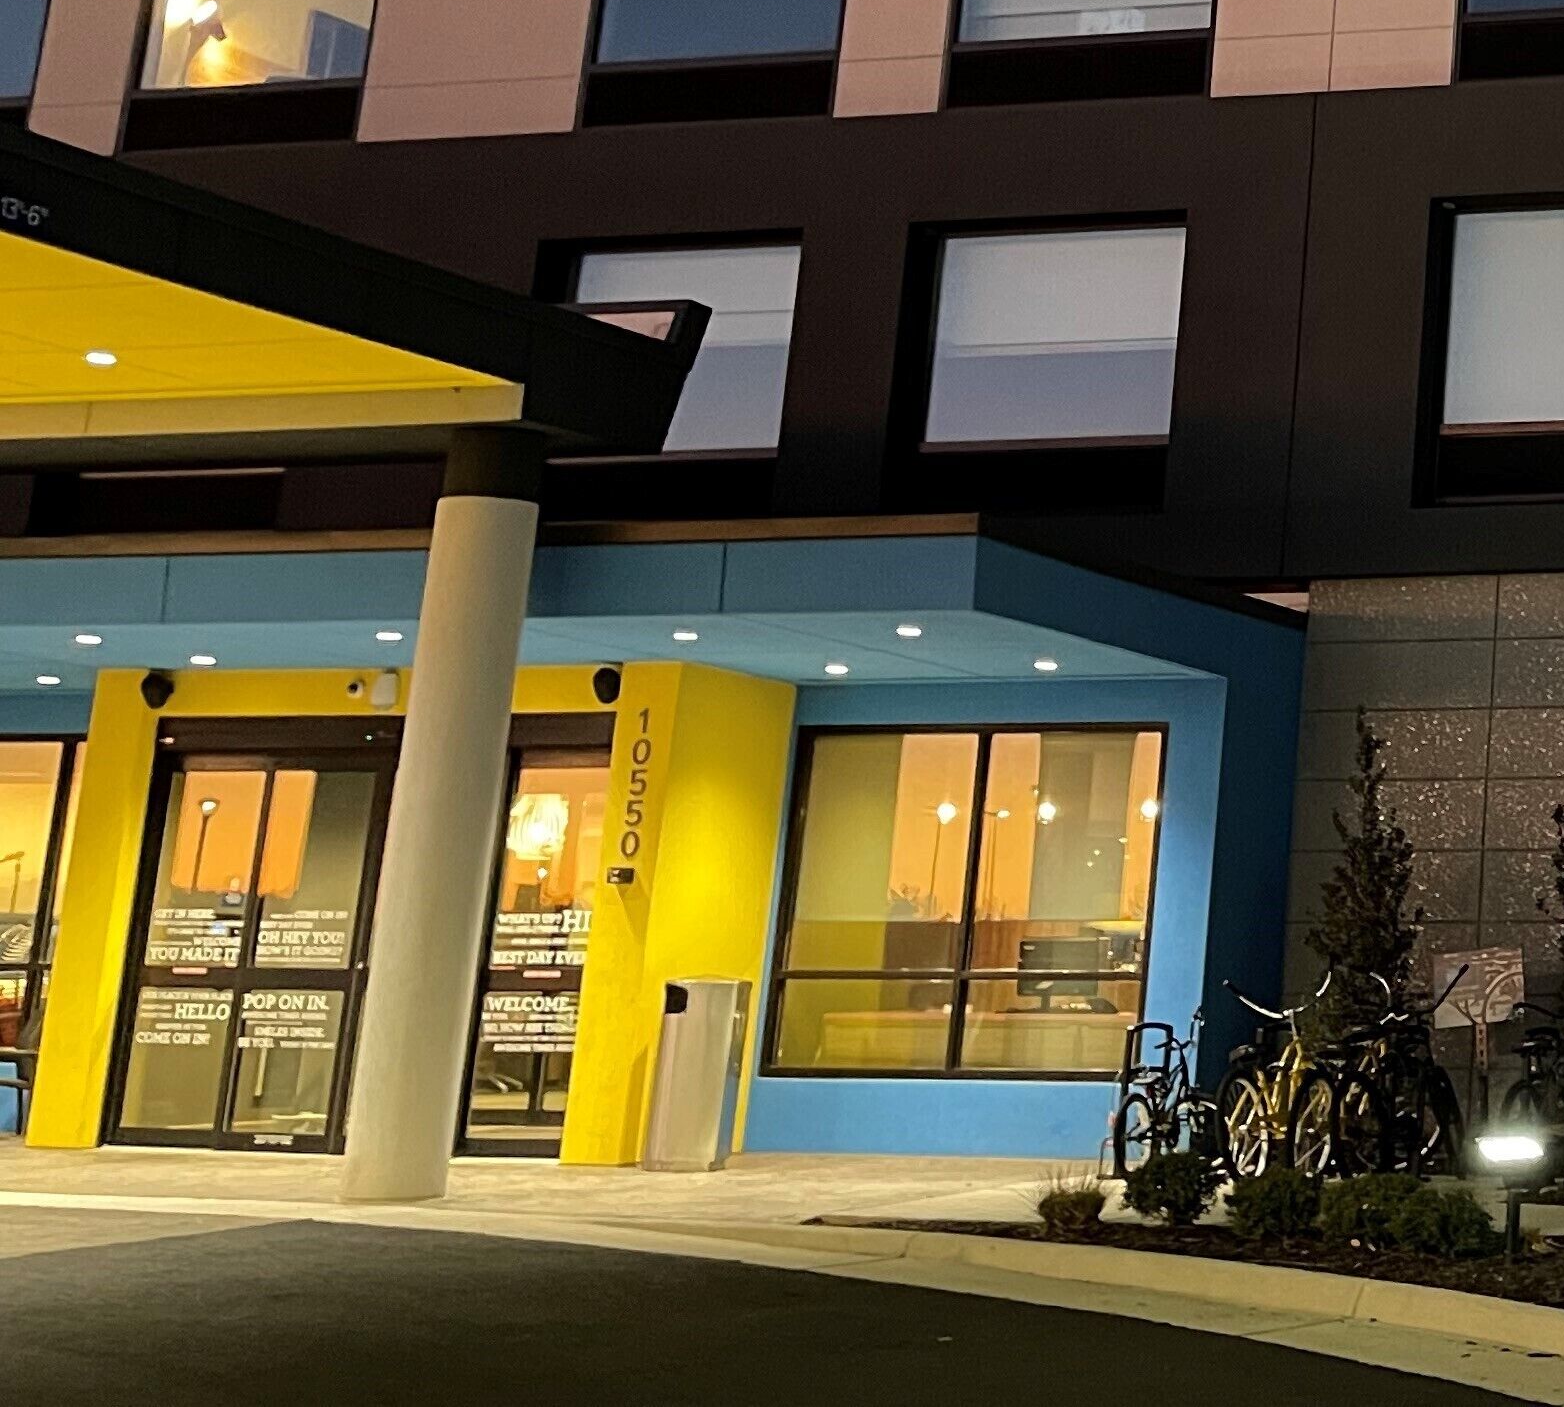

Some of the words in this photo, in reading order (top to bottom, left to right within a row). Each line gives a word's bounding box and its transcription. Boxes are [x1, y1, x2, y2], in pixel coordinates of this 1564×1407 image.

[620, 708, 652, 859] 10550
[257, 930, 281, 944] OH
[281, 930, 311, 945] HEY
[149, 947, 180, 961] YOU
[180, 947, 223, 962] MADE
[492, 950, 529, 965] BEST
[526, 950, 557, 965] DAY
[241, 993, 277, 1010] POP
[278, 994, 306, 1010] ON
[174, 1002, 231, 1021] HELLO
